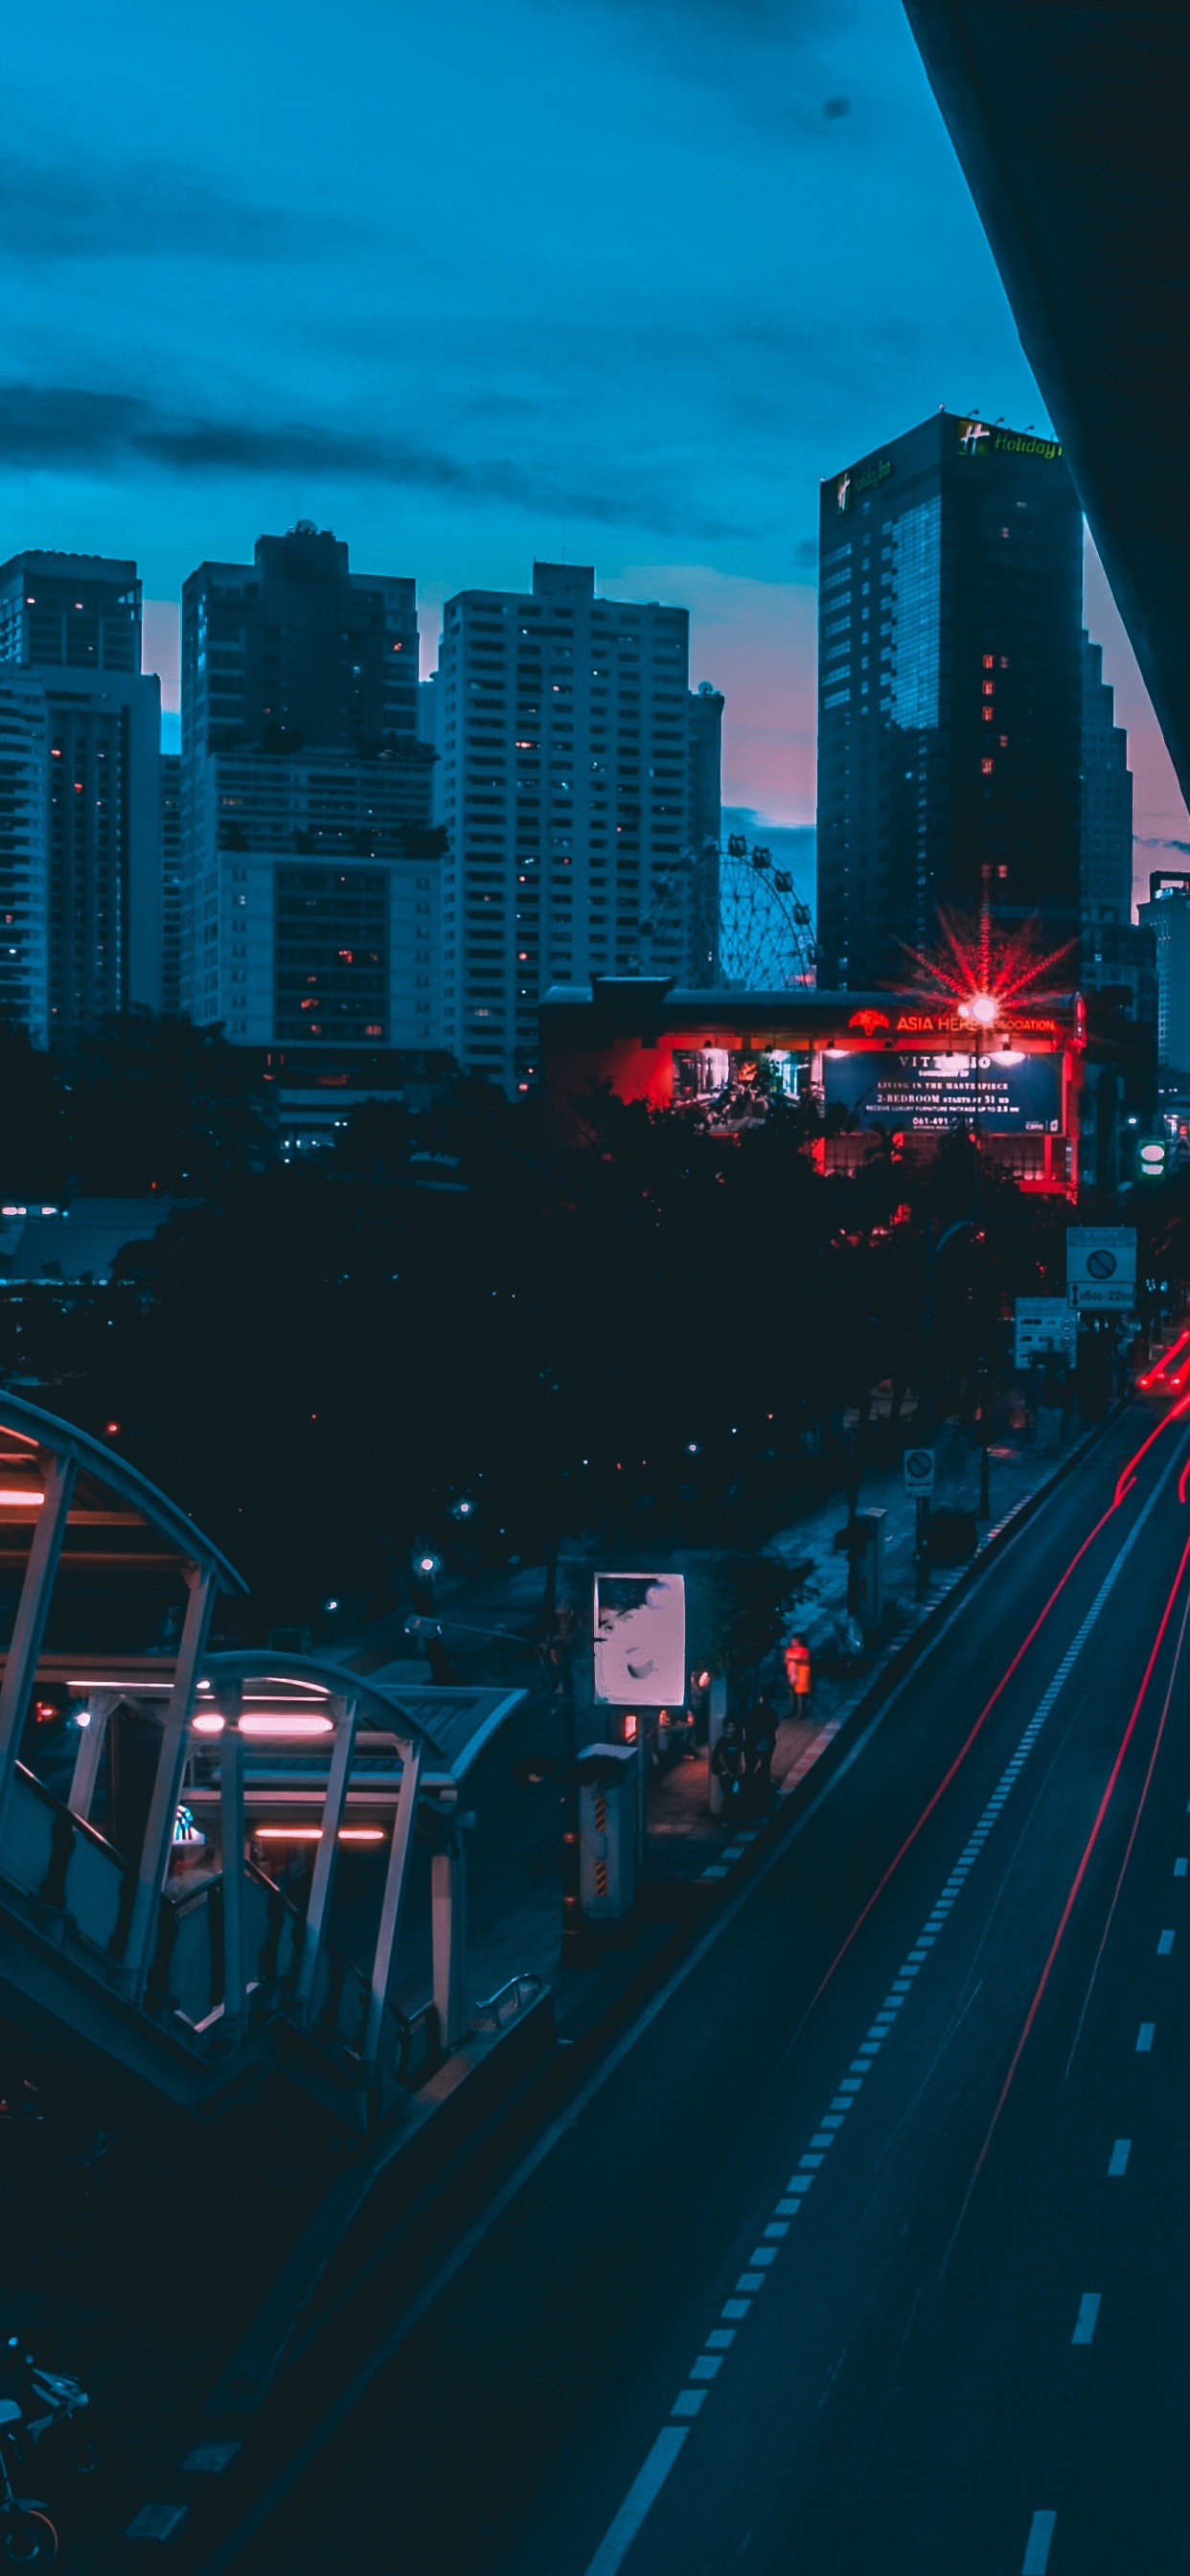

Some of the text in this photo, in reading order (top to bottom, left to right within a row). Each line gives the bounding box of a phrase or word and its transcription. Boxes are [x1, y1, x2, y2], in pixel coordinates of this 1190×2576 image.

[995, 431, 1056, 460] Holiday
[896, 1017, 934, 1032] ASIA
[877, 1081, 909, 1090] LIVING
[925, 1082, 943, 1091] THE
[876, 1093, 941, 1104] 2-BEDROOM
